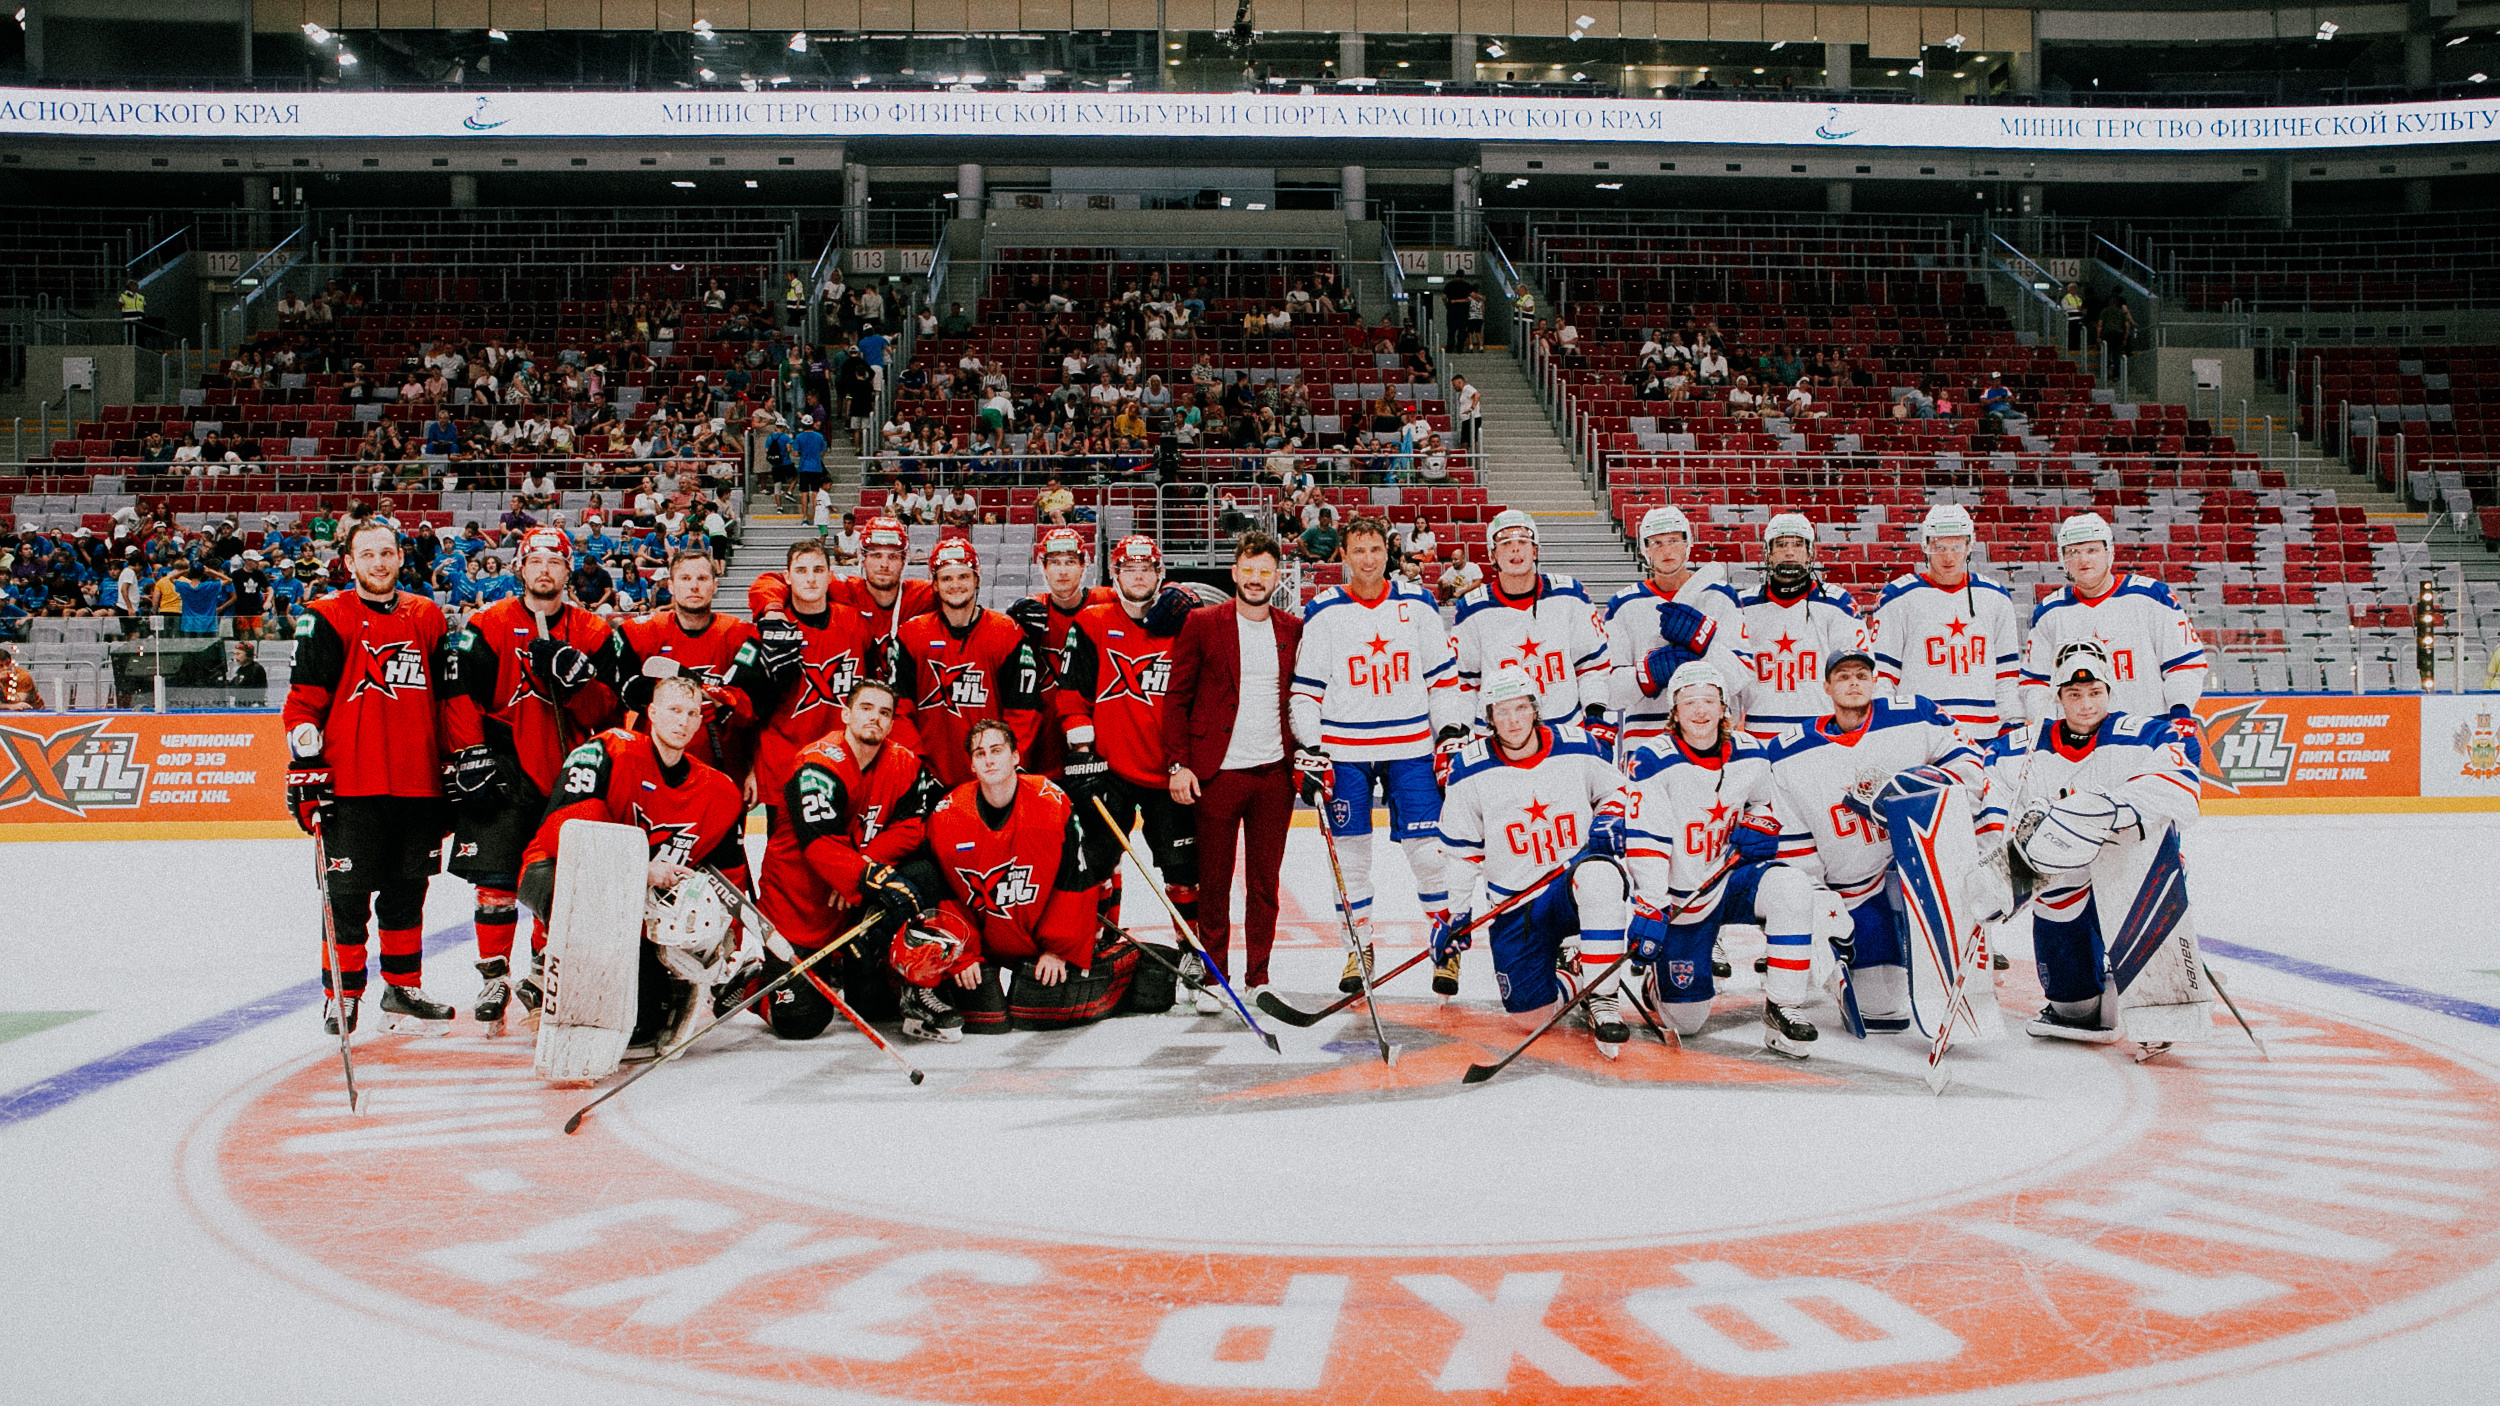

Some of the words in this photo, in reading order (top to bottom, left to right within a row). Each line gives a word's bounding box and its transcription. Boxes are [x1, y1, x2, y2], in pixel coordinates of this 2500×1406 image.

[0, 101, 225, 125] АСНОДАРСКОГО
[234, 104, 300, 124] КРАЯ
[662, 103, 880, 123] МИНИСТЕРСТВО
[888, 100, 1067, 124] ФИЗИЧЕСКОЙ
[1076, 104, 1210, 124] КУЛЬТУРЫ
[1221, 105, 1237, 124] И
[1245, 105, 1348, 125] СПОРТА
[1357, 106, 1592, 129] КРАСНОДАРСКОГО
[1601, 110, 1662, 130] КРАЯ
[2000, 117, 2203, 139] МИНИСТЕРСТВО
[2210, 110, 2388, 137] ФИЗИЧЕСКОЙ
[2396, 109, 2500, 134] КУЛЬТУ
[209, 254, 239, 272] 112
[853, 251, 882, 269] 113
[902, 251, 931, 269] 114
[1398, 253, 1426, 270] 114
[1445, 253, 1473, 270] 115
[2051, 261, 2078, 277] 116
[1398, 603, 1410, 622] C
[398, 652, 422, 663] TEAM
[1926, 635, 1986, 675] СКА
[1347, 651, 1410, 695] СКА
[1756, 651, 1818, 692] СКА
[1019, 669, 1037, 694] 17
[2306, 714, 2391, 728] ЧЕМПИОНАТ
[160, 733, 255, 748] ЧЕМПИОНАТ
[2302, 732, 2335, 746] ФХР
[156, 753, 194, 766] ФХР
[2298, 750, 2336, 764] ЛИГА
[2337, 749, 2391, 763] СТАВОК
[152, 771, 193, 785] ЛИГА
[195, 771, 257, 785] СТАВОК
[563, 766, 597, 794] 39
[2295, 768, 2338, 781] SOCHI
[2340, 768, 2368, 780] XHL
[149, 790, 199, 804] SOCHI
[199, 790, 231, 804] XHL
[1505, 813, 1579, 866] СКА
[2178, 936, 2199, 991] BAUER
[544, 955, 561, 1017] CCM
